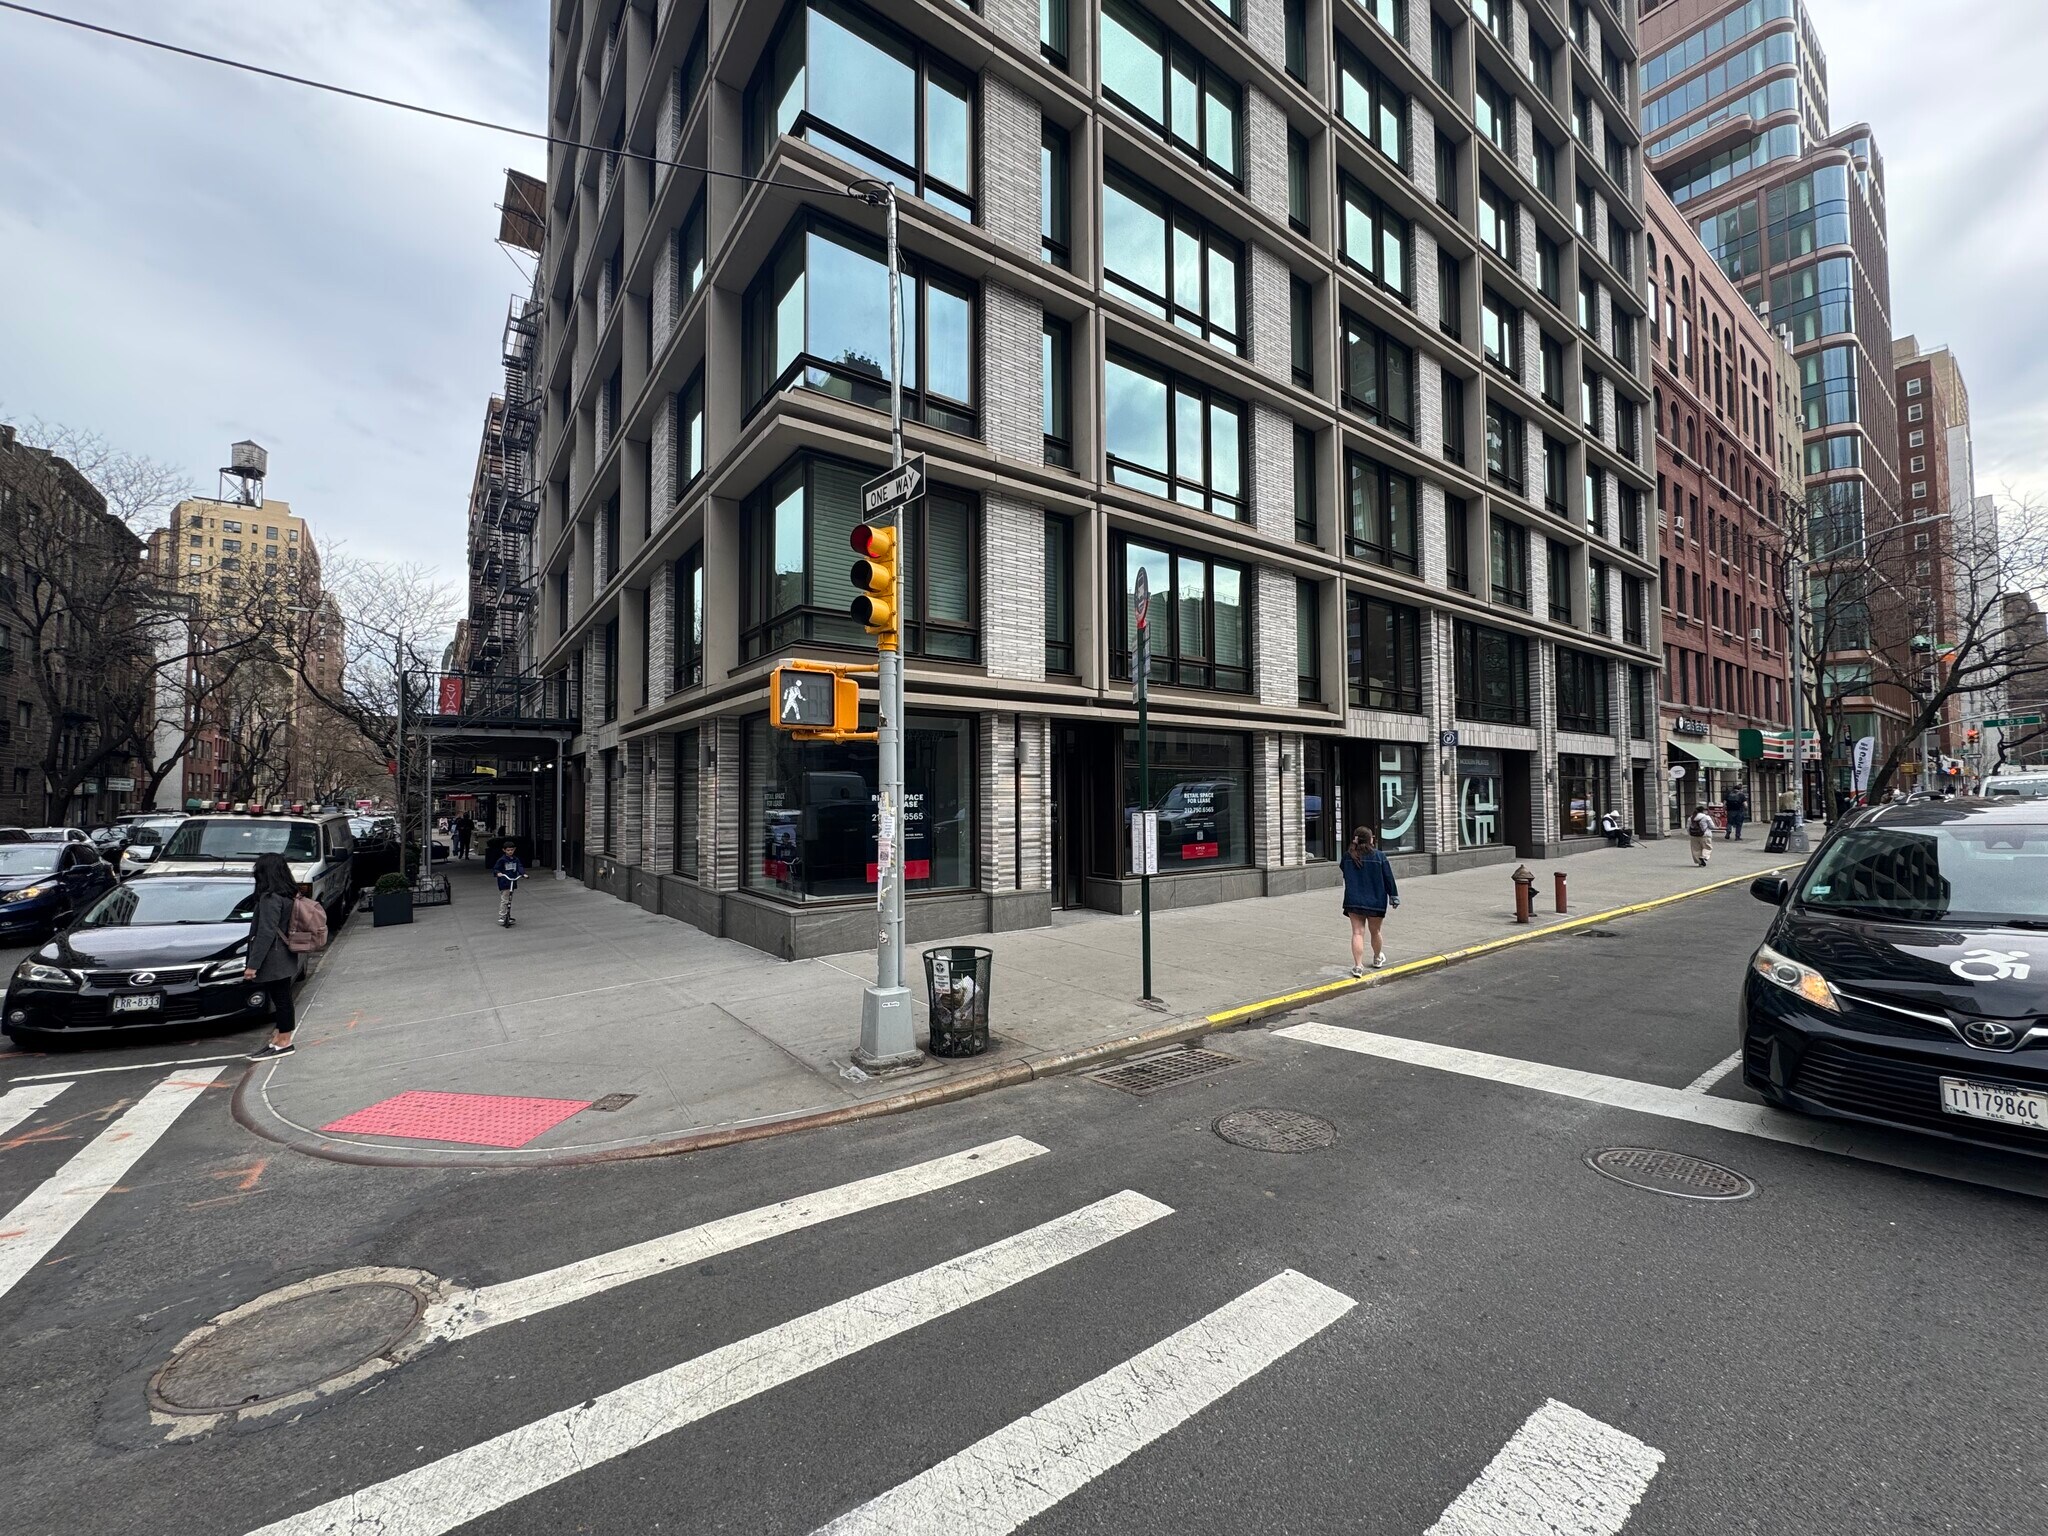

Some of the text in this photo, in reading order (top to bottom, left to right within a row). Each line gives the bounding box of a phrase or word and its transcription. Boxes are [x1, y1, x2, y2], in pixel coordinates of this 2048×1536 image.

[870, 472, 914, 506] ONE WAY
[446, 683, 456, 708] SVA
[115, 997, 160, 1008] LRR-8333
[1950, 1088, 2038, 1119] T117986C
[1968, 1084, 1989, 1093] NEW
[1991, 1088, 2020, 1098] YORK
